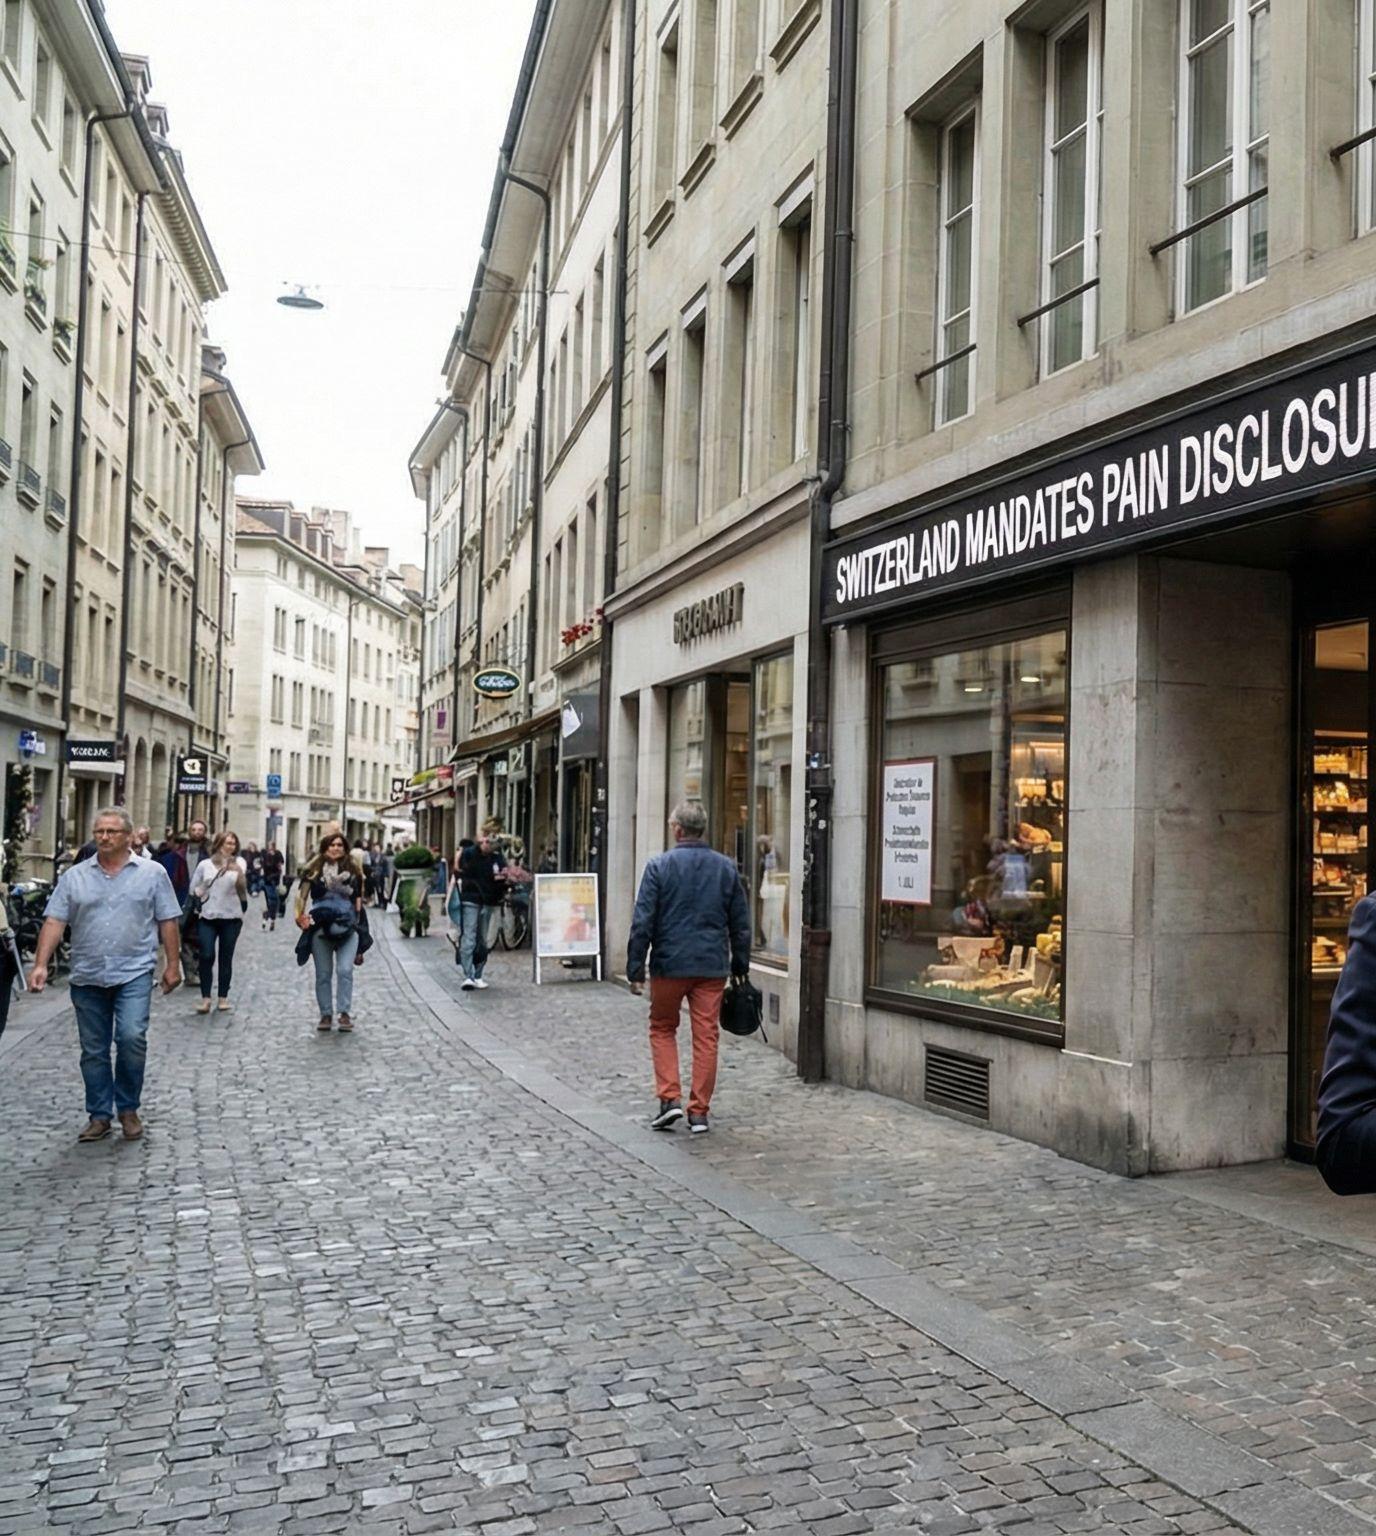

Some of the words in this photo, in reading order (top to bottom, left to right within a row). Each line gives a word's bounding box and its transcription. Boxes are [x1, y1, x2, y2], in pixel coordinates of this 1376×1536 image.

[837, 520, 960, 603] SWITZERLAND
[966, 472, 1094, 566] MANDATES
[1103, 445, 1168, 526] PAIN
